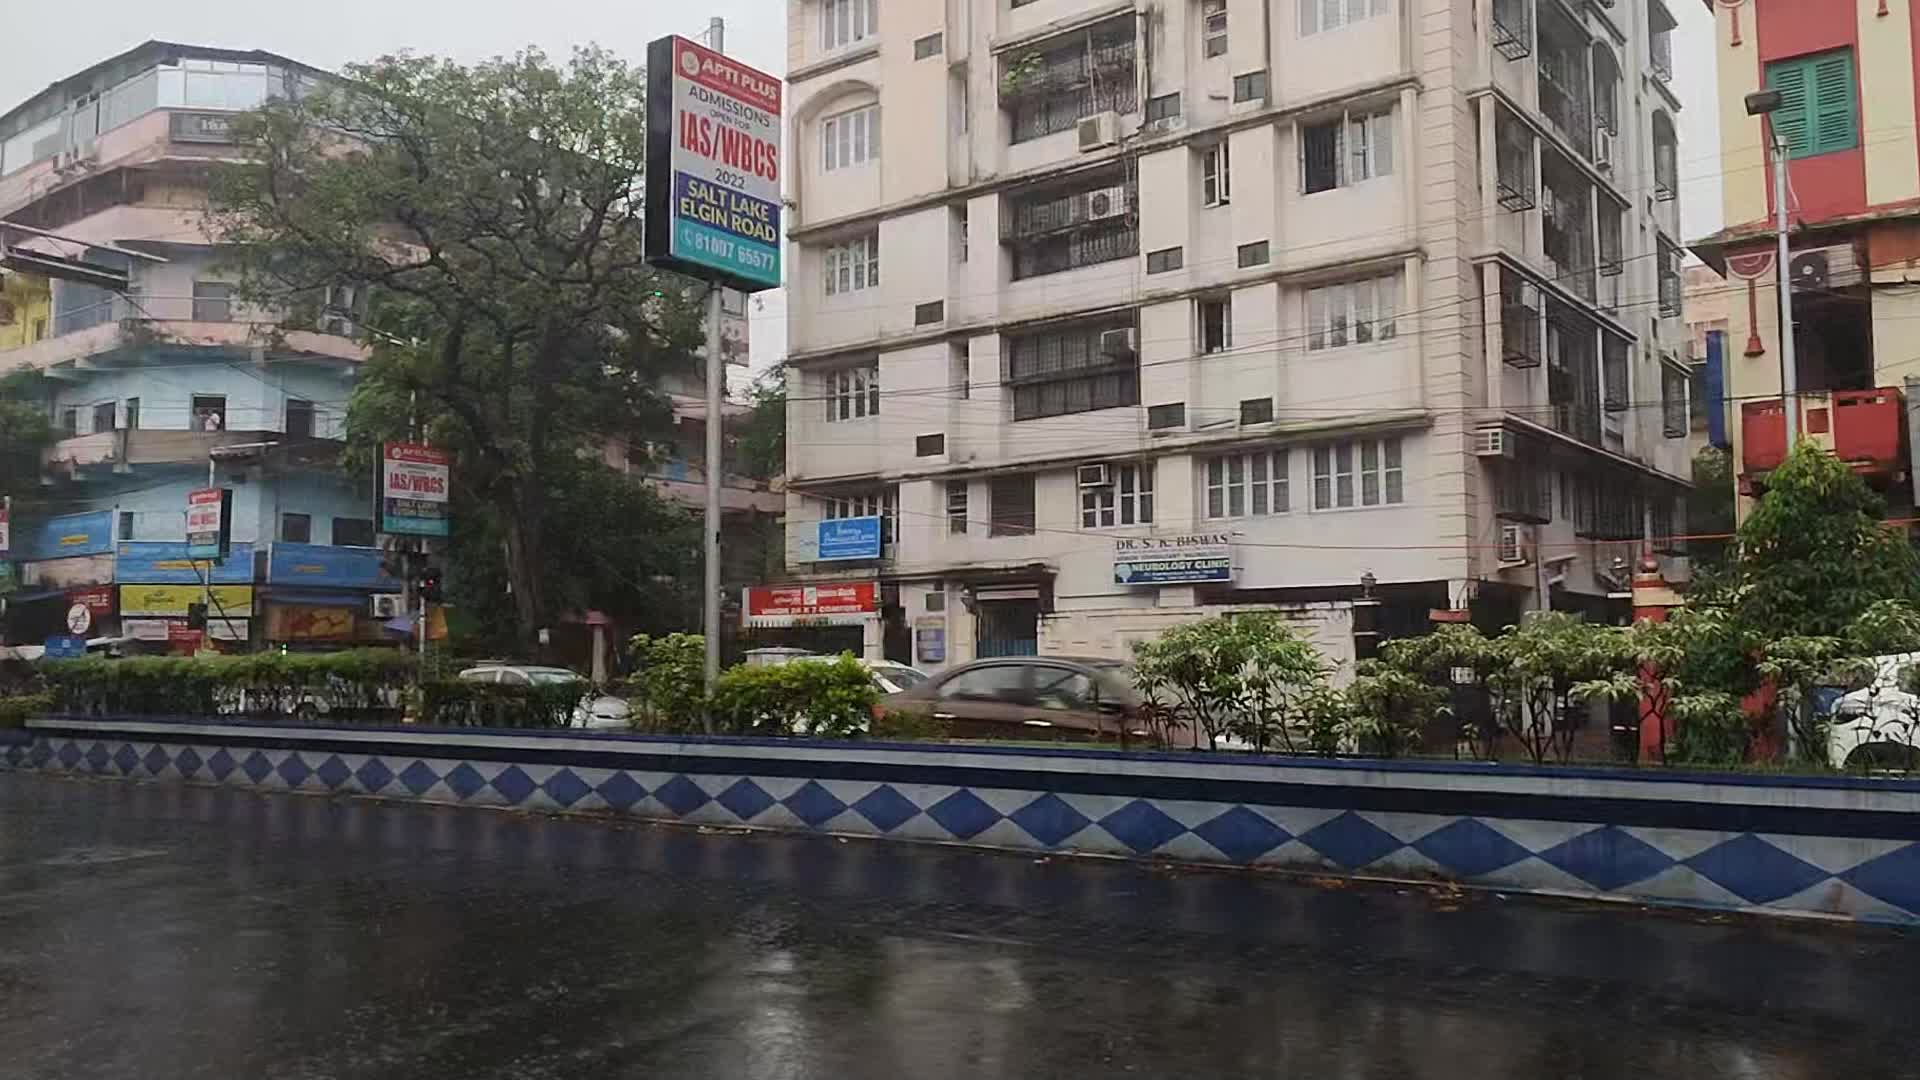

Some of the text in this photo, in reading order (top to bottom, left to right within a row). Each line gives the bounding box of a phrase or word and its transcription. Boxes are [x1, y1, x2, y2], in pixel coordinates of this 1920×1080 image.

[702, 58, 739, 84] APTI
[741, 74, 777, 99] PLUS
[688, 85, 771, 128] ADMISSIONS
[711, 109, 751, 130] OPEN FOR
[680, 109, 777, 182] IAS/WBCS
[715, 168, 745, 190] 2022
[688, 180, 769, 221] SALT LAKE
[680, 197, 777, 242] ELGIN ROAD
[695, 232, 735, 259] 81007
[1116, 540, 1138, 550] DR.
[1143, 538, 1155, 549] S.
[1131, 559, 1230, 571] NEUROLOGY CLINIC
